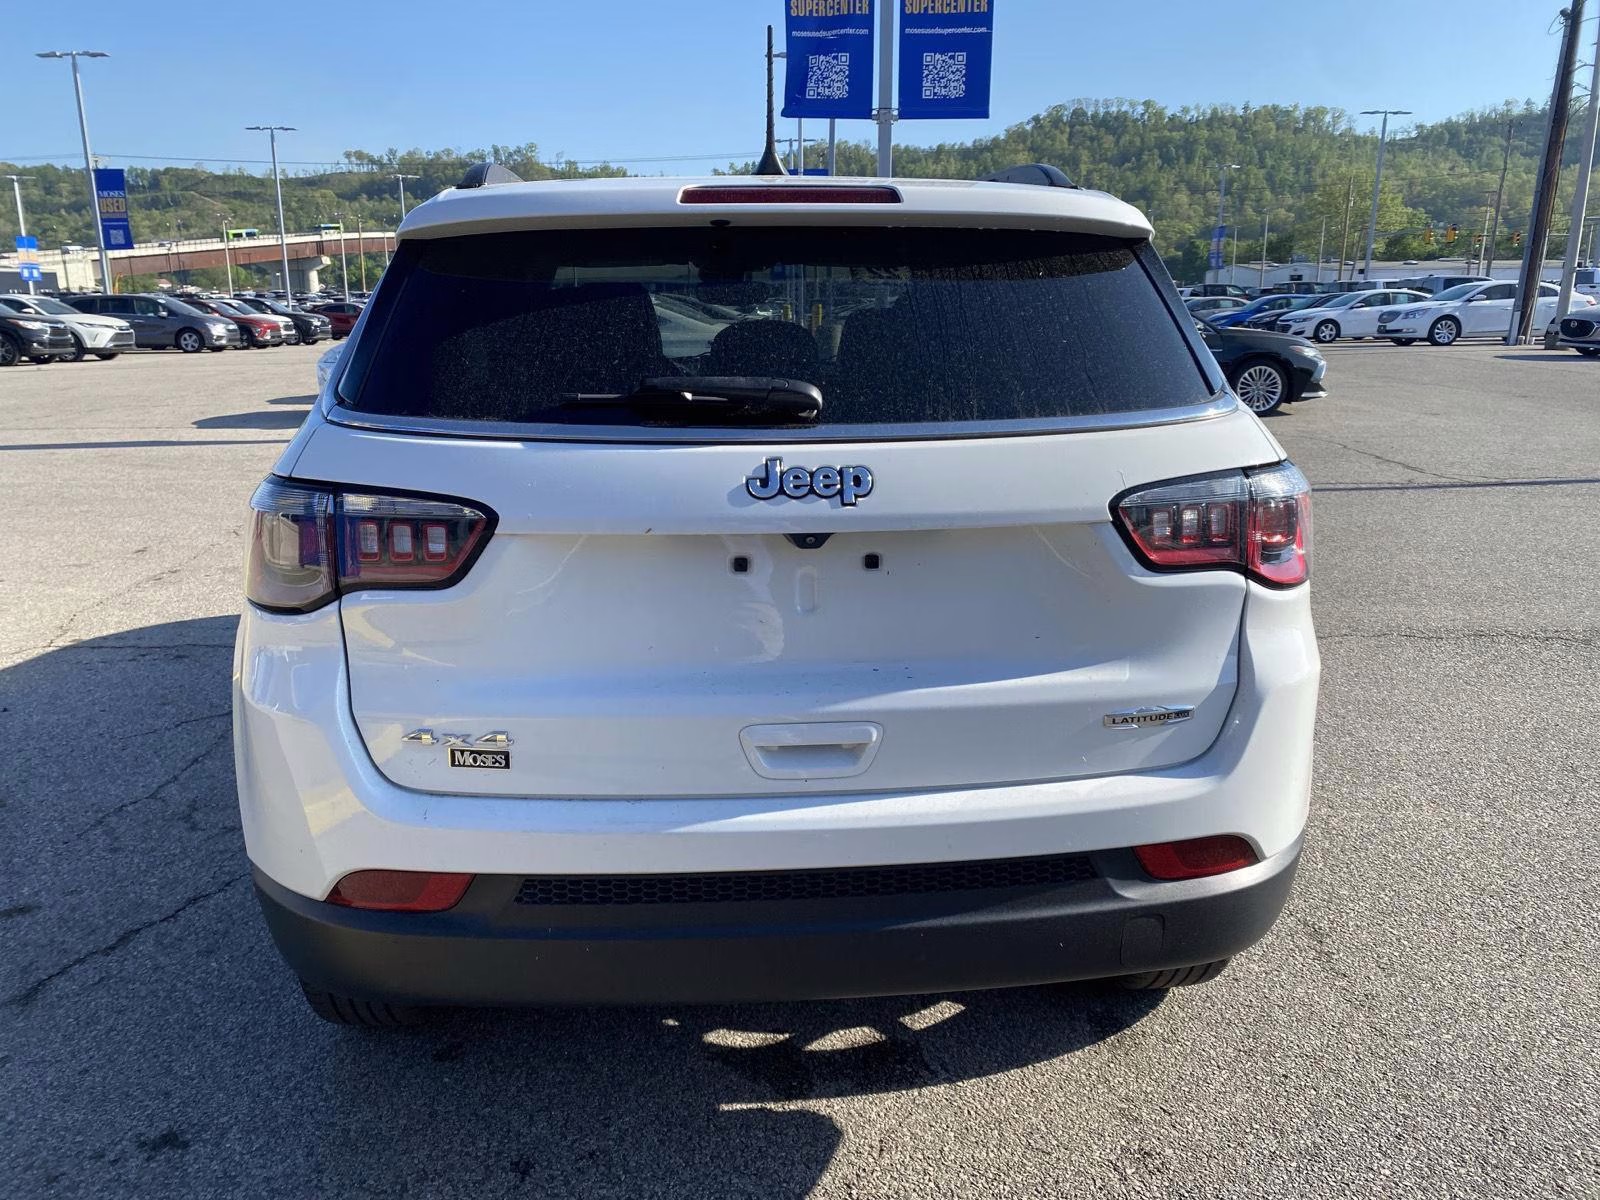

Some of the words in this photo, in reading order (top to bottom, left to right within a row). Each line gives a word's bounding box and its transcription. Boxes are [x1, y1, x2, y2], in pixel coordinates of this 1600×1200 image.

[790, 0, 869, 16] SUPERCENTER
[905, 0, 988, 14] SUPERCENTER
[791, 27, 869, 37] mosesusedsupercenter.com
[905, 26, 987, 35] mosesusedsupercenter.com
[100, 198, 126, 212] USED
[744, 456, 874, 506] Jeep
[1112, 712, 1173, 724] LATITUDE
